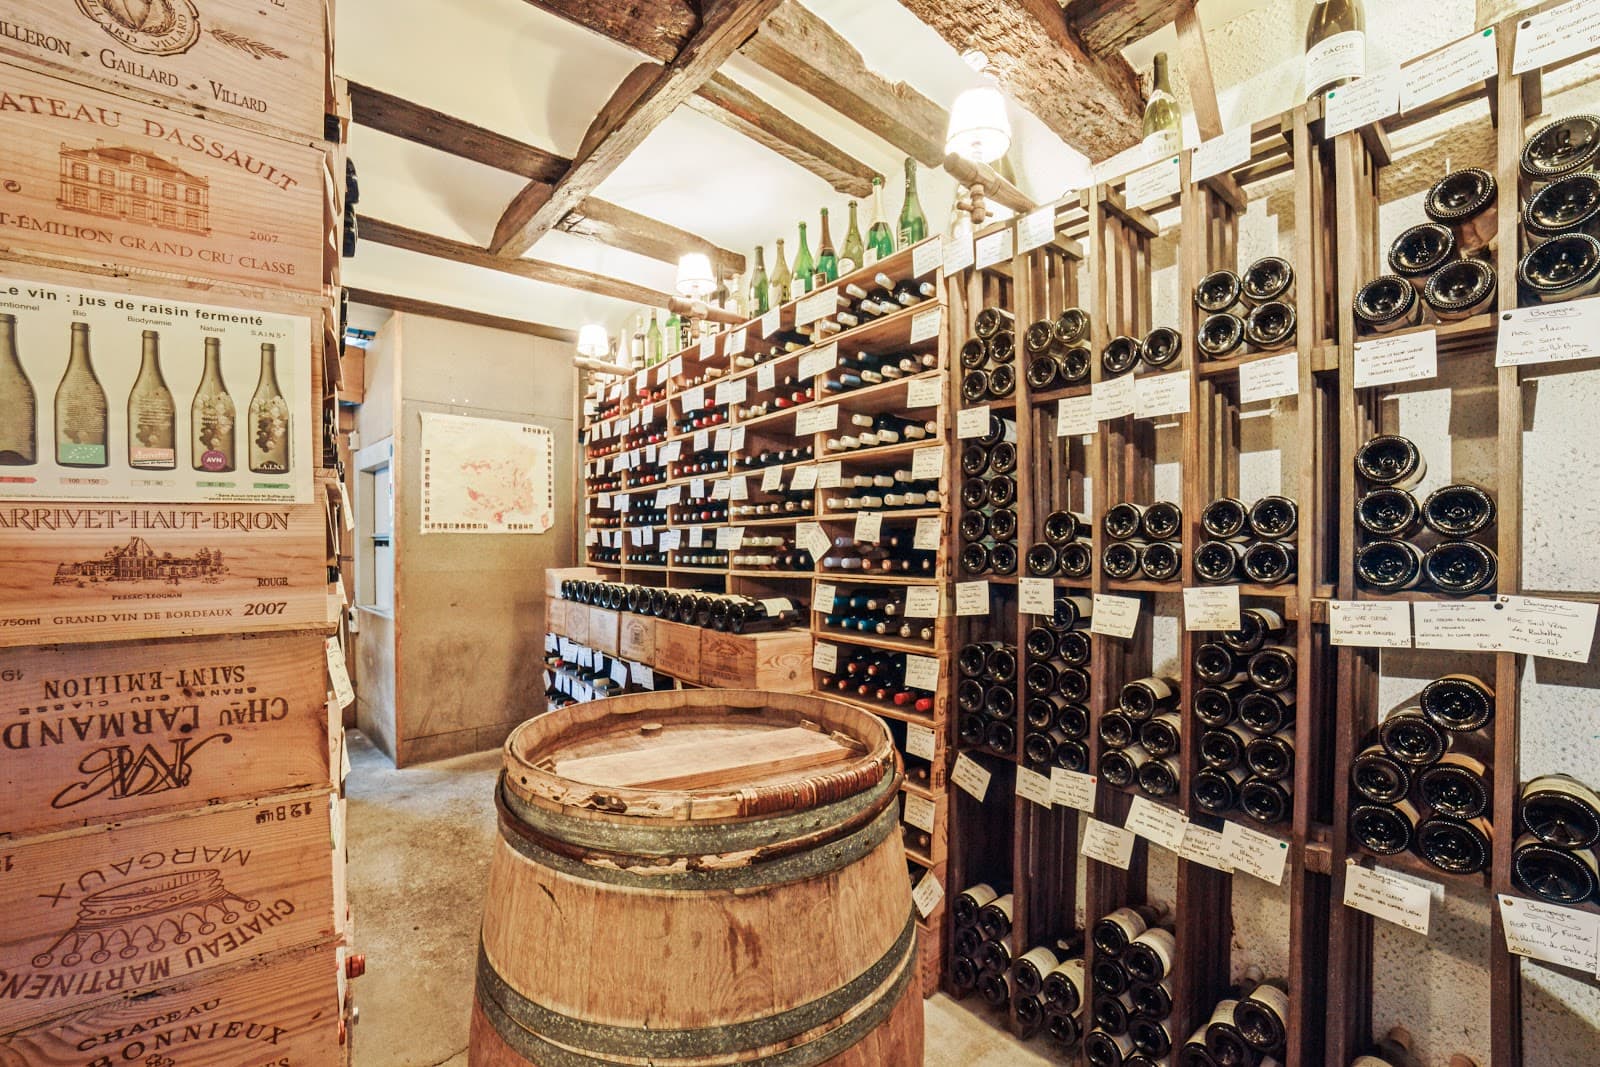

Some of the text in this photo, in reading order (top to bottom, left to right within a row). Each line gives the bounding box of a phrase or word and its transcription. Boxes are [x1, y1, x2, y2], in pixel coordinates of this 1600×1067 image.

[151, 14, 188, 48] VILLARD
[99, 48, 179, 88] GAILLARD
[208, 80, 268, 113] VILLARD
[0, 91, 298, 192] ATEAU DASSAULT
[249, 230, 280, 244] 2007
[119, 234, 194, 259] GRAND
[198, 248, 234, 266] CRU
[27, 288, 58, 301] vin
[78, 292, 107, 308] jus
[114, 298, 135, 311] de
[142, 302, 189, 318] raisin
[195, 308, 264, 327] fermenté
[72, 309, 88, 318] Bio
[127, 314, 173, 327] Biodynamie
[200, 324, 226, 334] Naturel
[257, 576, 289, 588] ROUGE
[52, 614, 108, 626] GRAND
[112, 613, 138, 622] VIN
[143, 612, 161, 621] DE
[165, 607, 234, 620] BORDEAUX
[243, 602, 288, 617] 2007
[44, 665, 246, 699] SAINT-EMILION
[18, 700, 110, 716] CLASSE
[130, 694, 171, 706] CRU
[289, 802, 312, 817] 12
[38, 846, 251, 909] MARGAUX
[184, 898, 297, 969] CHATEAU
[77, 998, 222, 1051] CHATEAU
